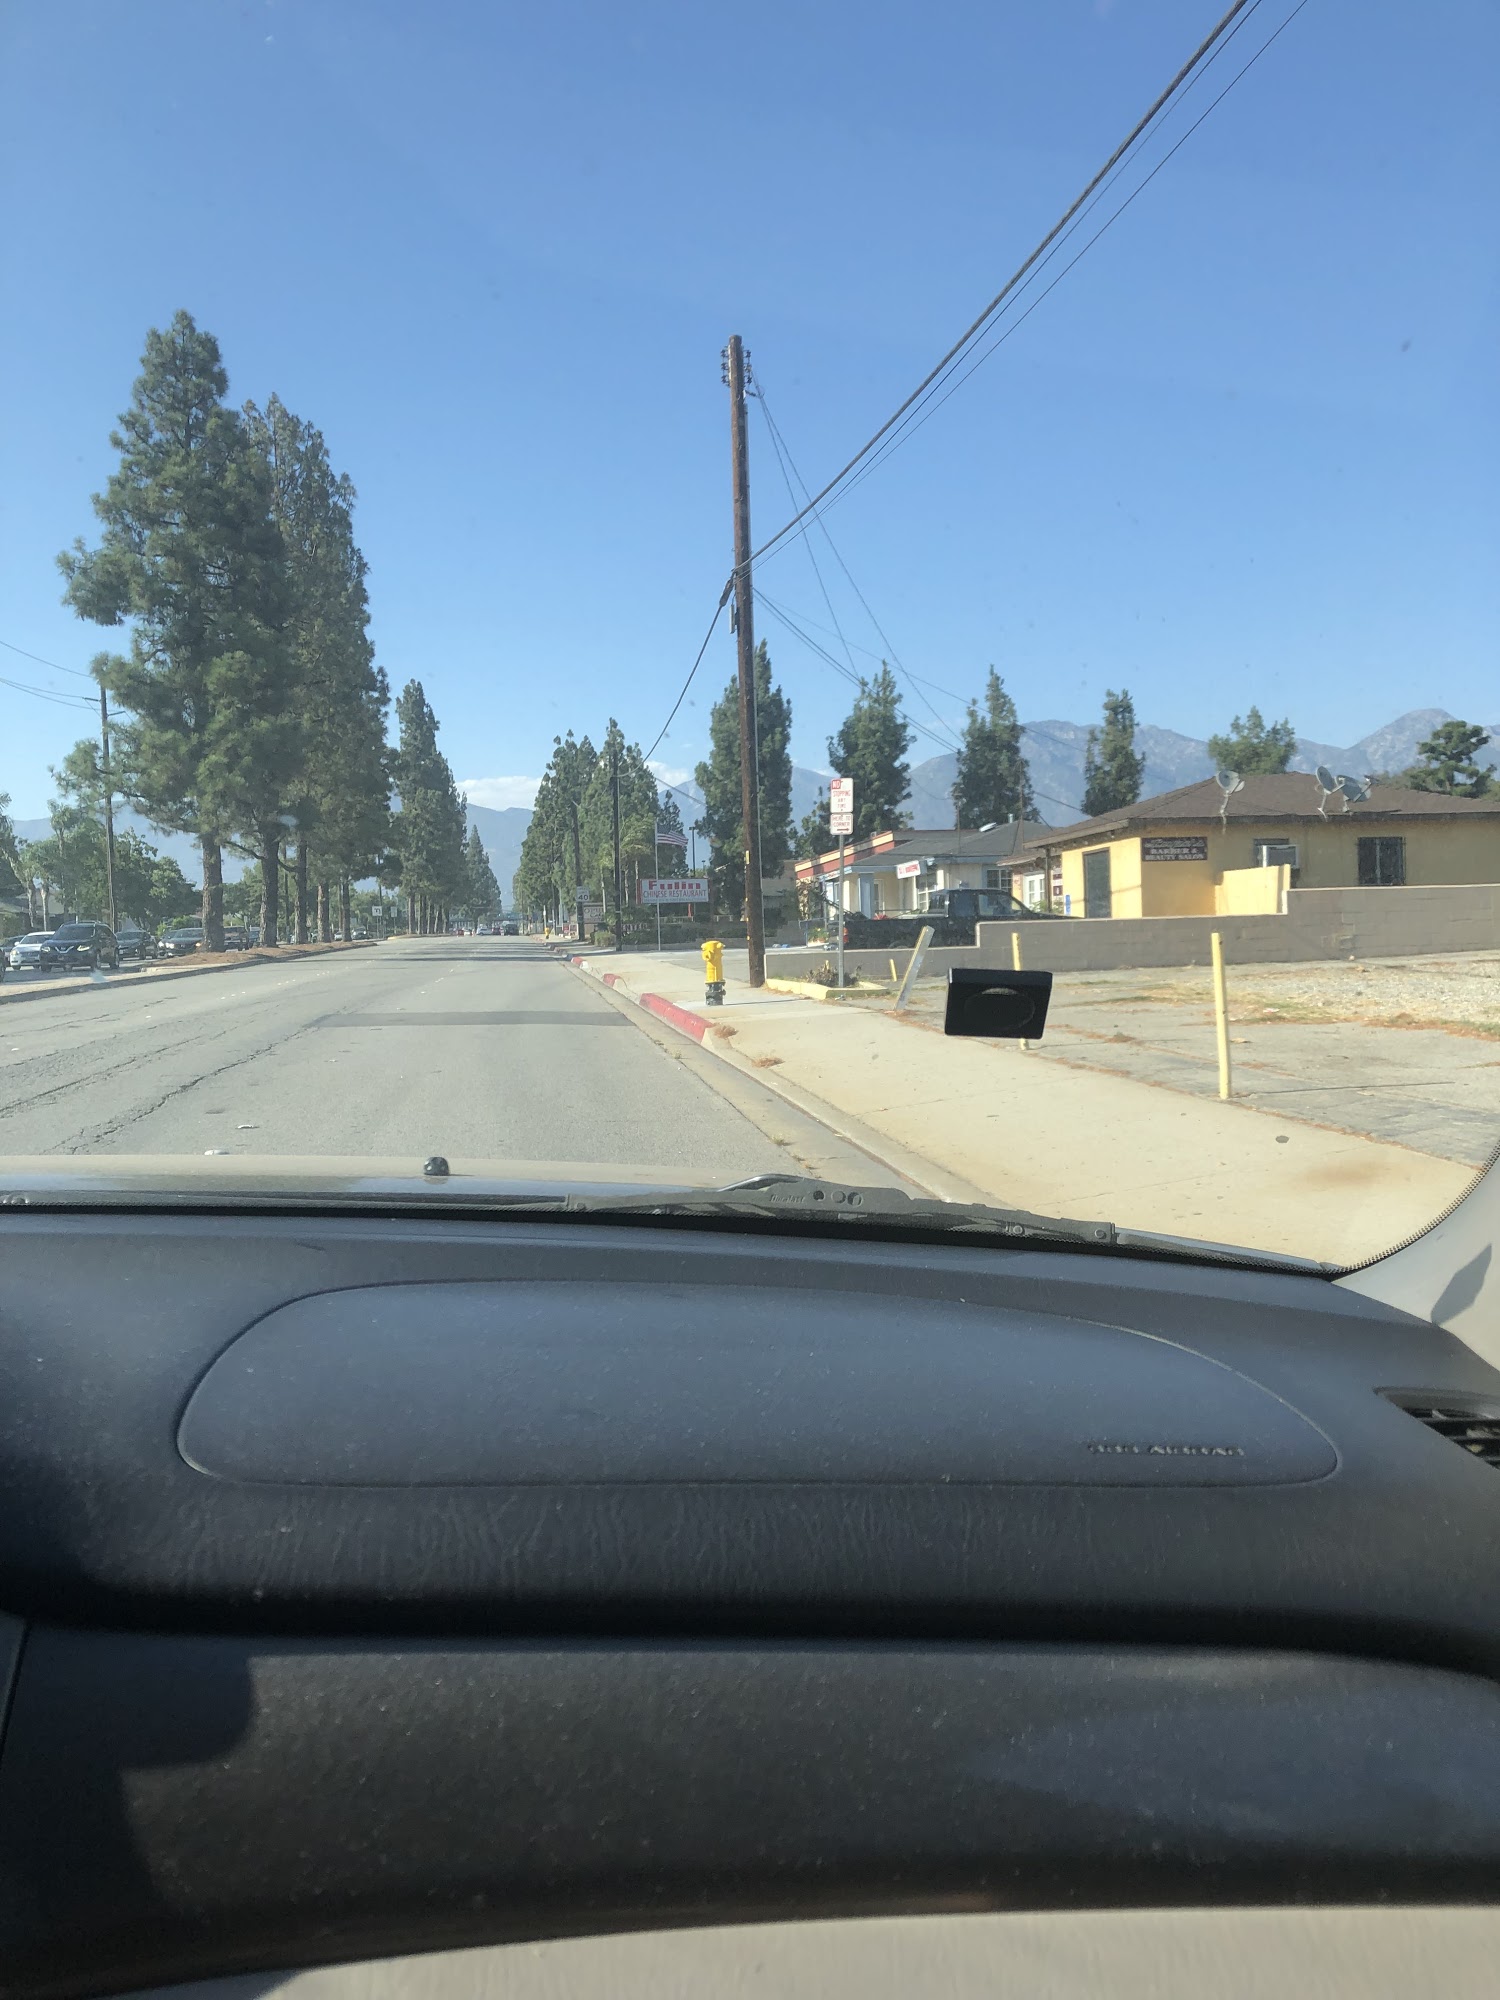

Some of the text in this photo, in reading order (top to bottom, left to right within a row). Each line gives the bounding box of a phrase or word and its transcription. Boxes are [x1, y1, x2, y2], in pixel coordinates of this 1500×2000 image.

[832, 780, 841, 789] NO
[643, 889, 706, 898] CHINESE RESTAURANT
